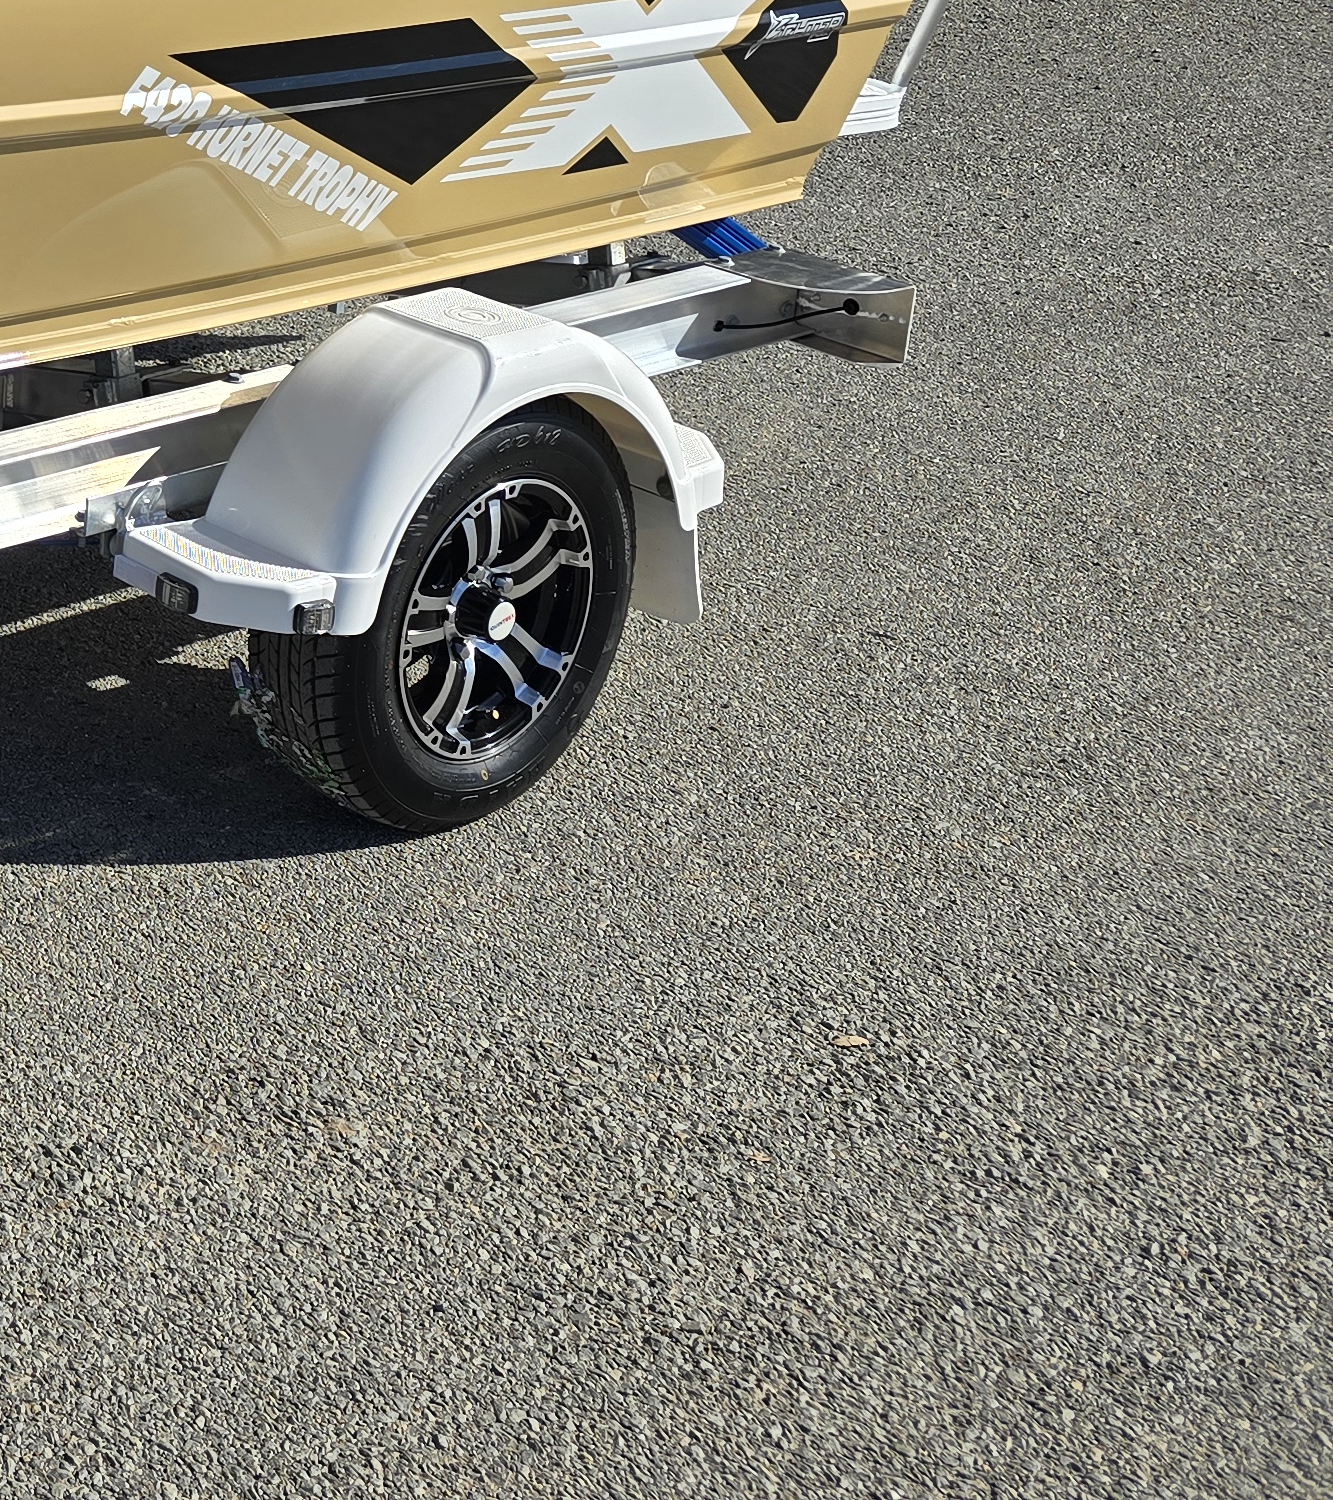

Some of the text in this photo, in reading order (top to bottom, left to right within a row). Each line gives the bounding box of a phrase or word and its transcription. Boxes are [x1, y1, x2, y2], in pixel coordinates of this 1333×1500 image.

[119, 65, 399, 232] F420 HORNET TROPHY
